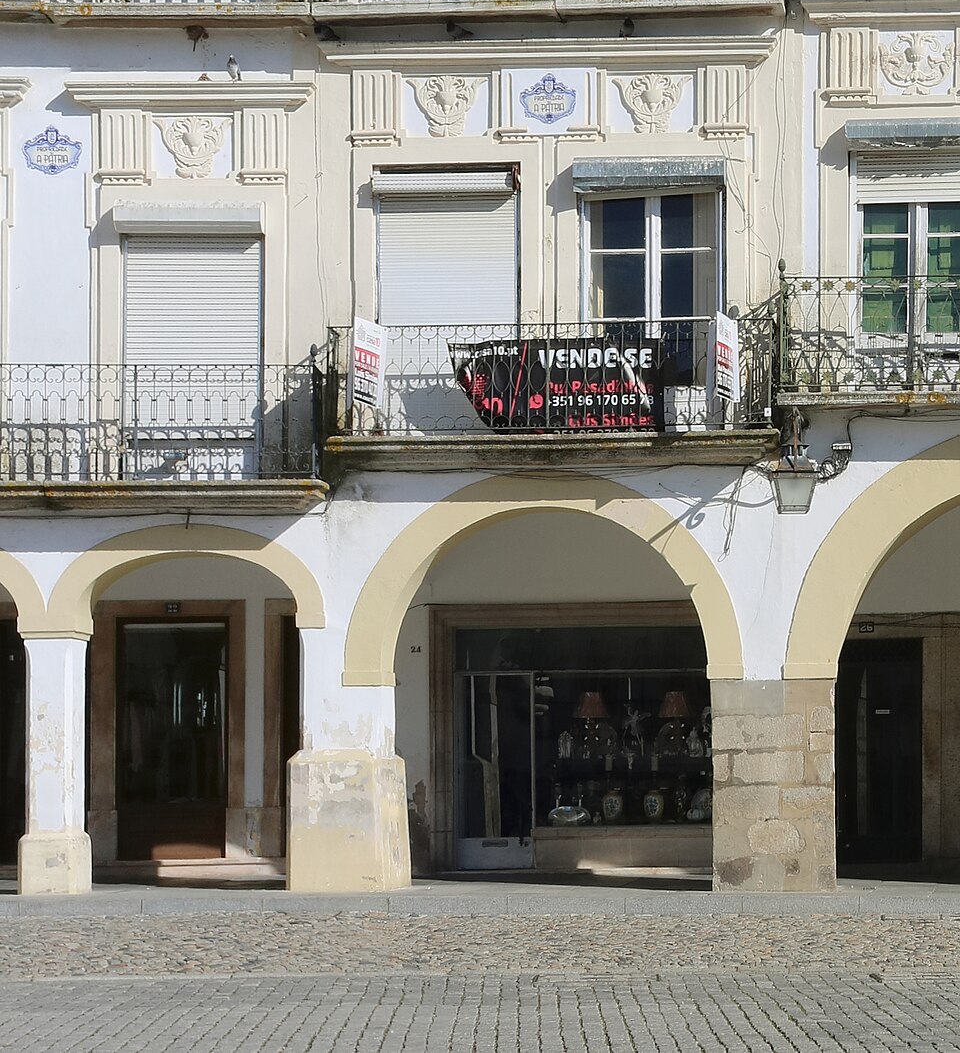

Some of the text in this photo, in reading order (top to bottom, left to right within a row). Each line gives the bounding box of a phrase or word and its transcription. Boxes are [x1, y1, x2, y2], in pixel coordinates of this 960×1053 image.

[534, 103, 539, 112] A
[36, 154, 42, 163] A
[577, 395, 593, 406] 96
[597, 395, 618, 406] 170
[621, 394, 636, 405] 65
